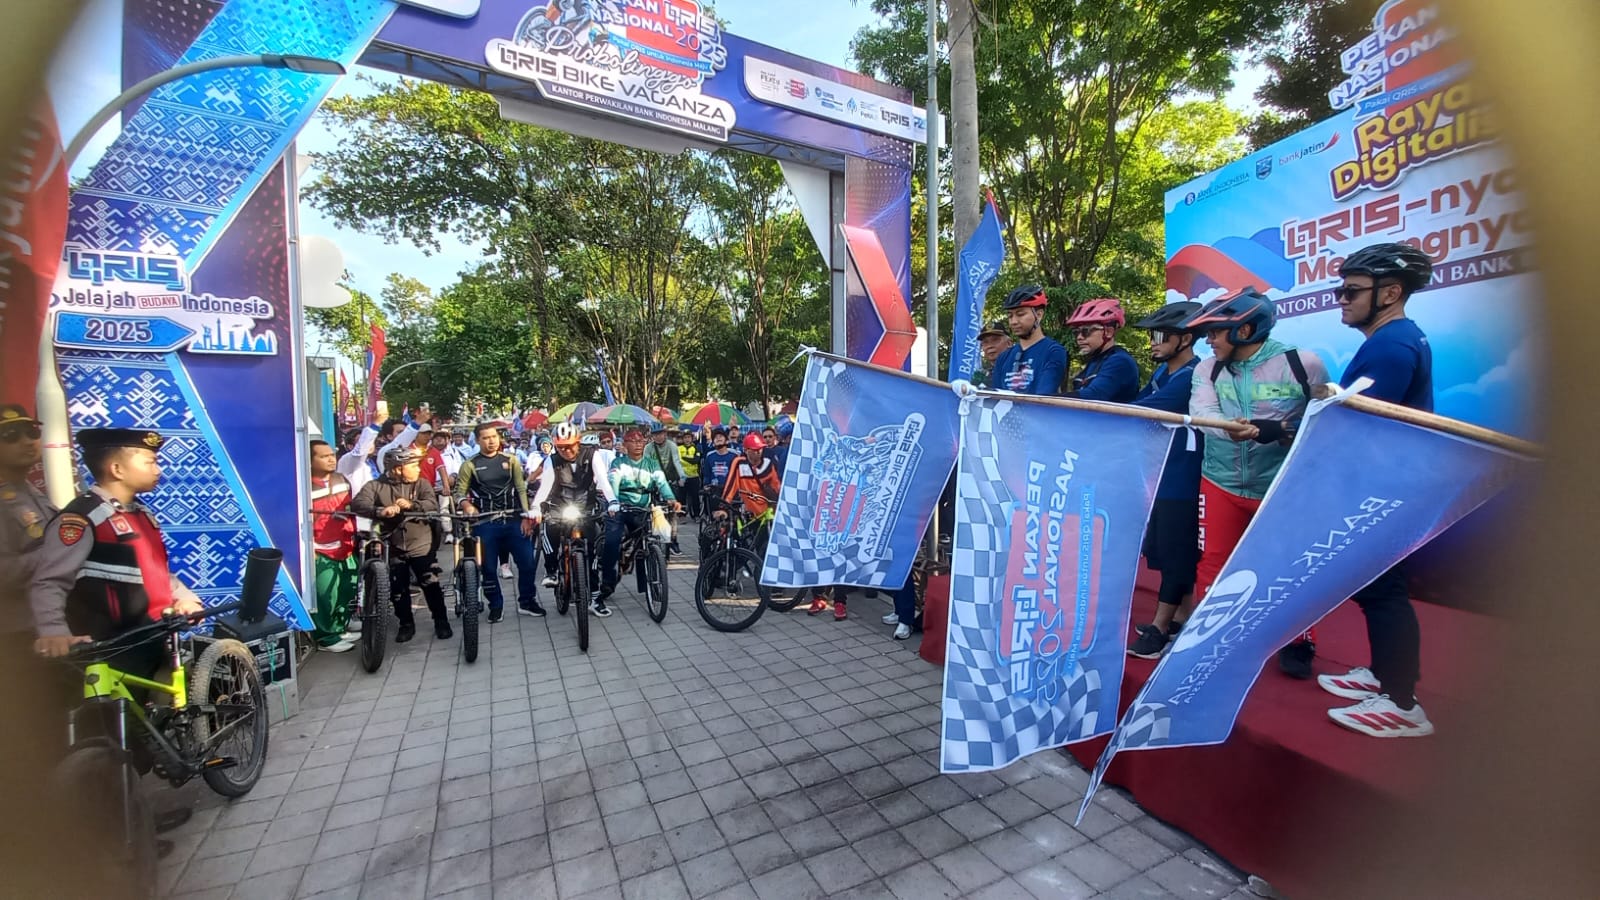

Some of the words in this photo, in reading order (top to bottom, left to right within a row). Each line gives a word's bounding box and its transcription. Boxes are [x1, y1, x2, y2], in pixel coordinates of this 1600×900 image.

[589, 9, 674, 37] NASIONAL
[661, 1, 718, 40] QRIS
[543, 26, 696, 92] Probolinggo
[498, 46, 558, 79] QRIS
[562, 66, 615, 91] BIKE
[619, 80, 727, 122] VAGANZA
[551, 83, 584, 100] KANTOR
[585, 93, 634, 114] PERWAKILAN
[634, 104, 655, 118] BANK
[655, 110, 692, 127] INDONESIA
[692, 120, 722, 135] MALANG
[880, 107, 911, 129] QRIS
[1356, 84, 1472, 151] Raya
[1278, 142, 1325, 166] bankjatim
[65, 244, 185, 291] QRIS
[1450, 256, 1514, 281] BANK
[63, 288, 137, 310] Jelajah
[140, 296, 179, 308] BUDAYA
[182, 294, 270, 316] Indonesia
[85, 318, 152, 342] 2025
[959, 335, 978, 375] BANK
